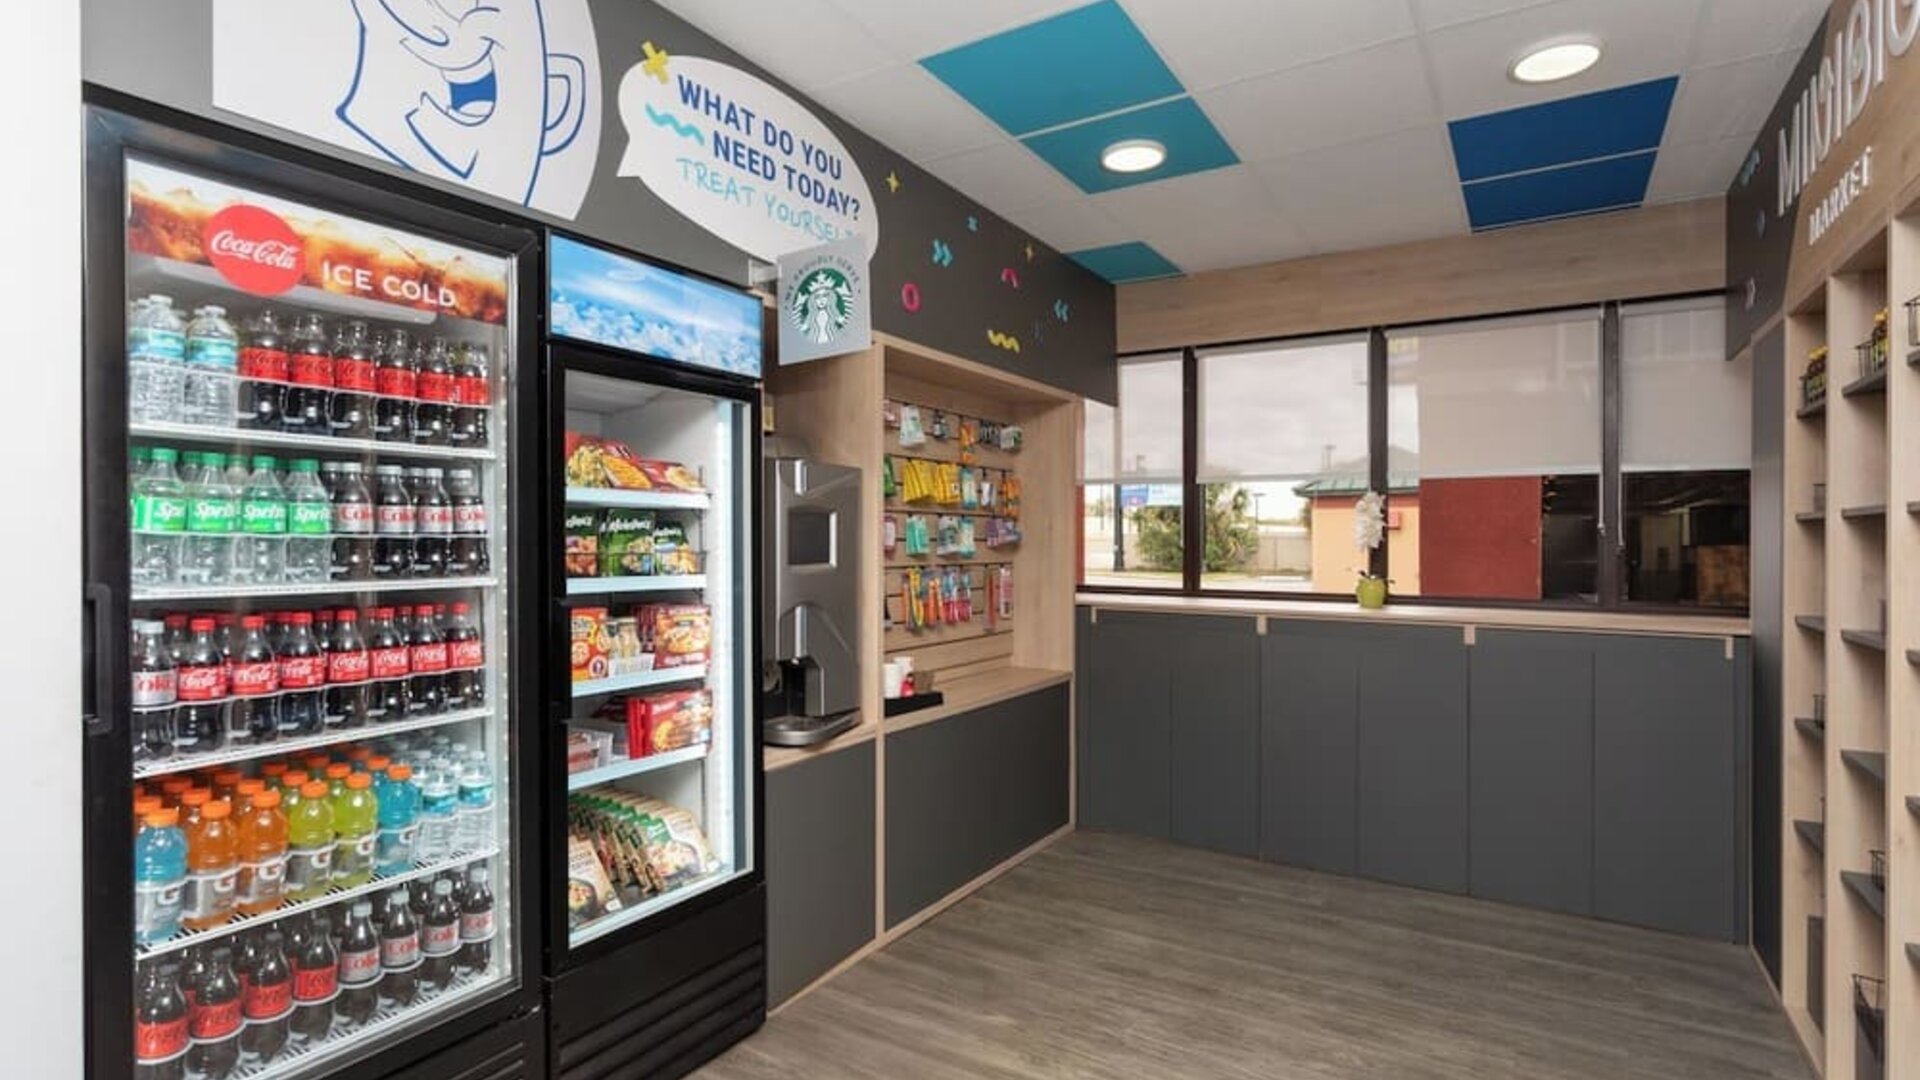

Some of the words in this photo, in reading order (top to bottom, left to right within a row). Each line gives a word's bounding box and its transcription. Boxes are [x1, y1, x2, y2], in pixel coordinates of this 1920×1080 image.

[678, 74, 755, 135] WHAT
[763, 120, 794, 156] DO
[802, 139, 842, 181] YOU
[675, 157, 756, 206] TREAT
[713, 131, 776, 182] NEED
[783, 164, 861, 221] TODAY?
[1808, 145, 1873, 245] MARKET
[322, 259, 373, 292] ICE
[382, 275, 457, 308] COLD
